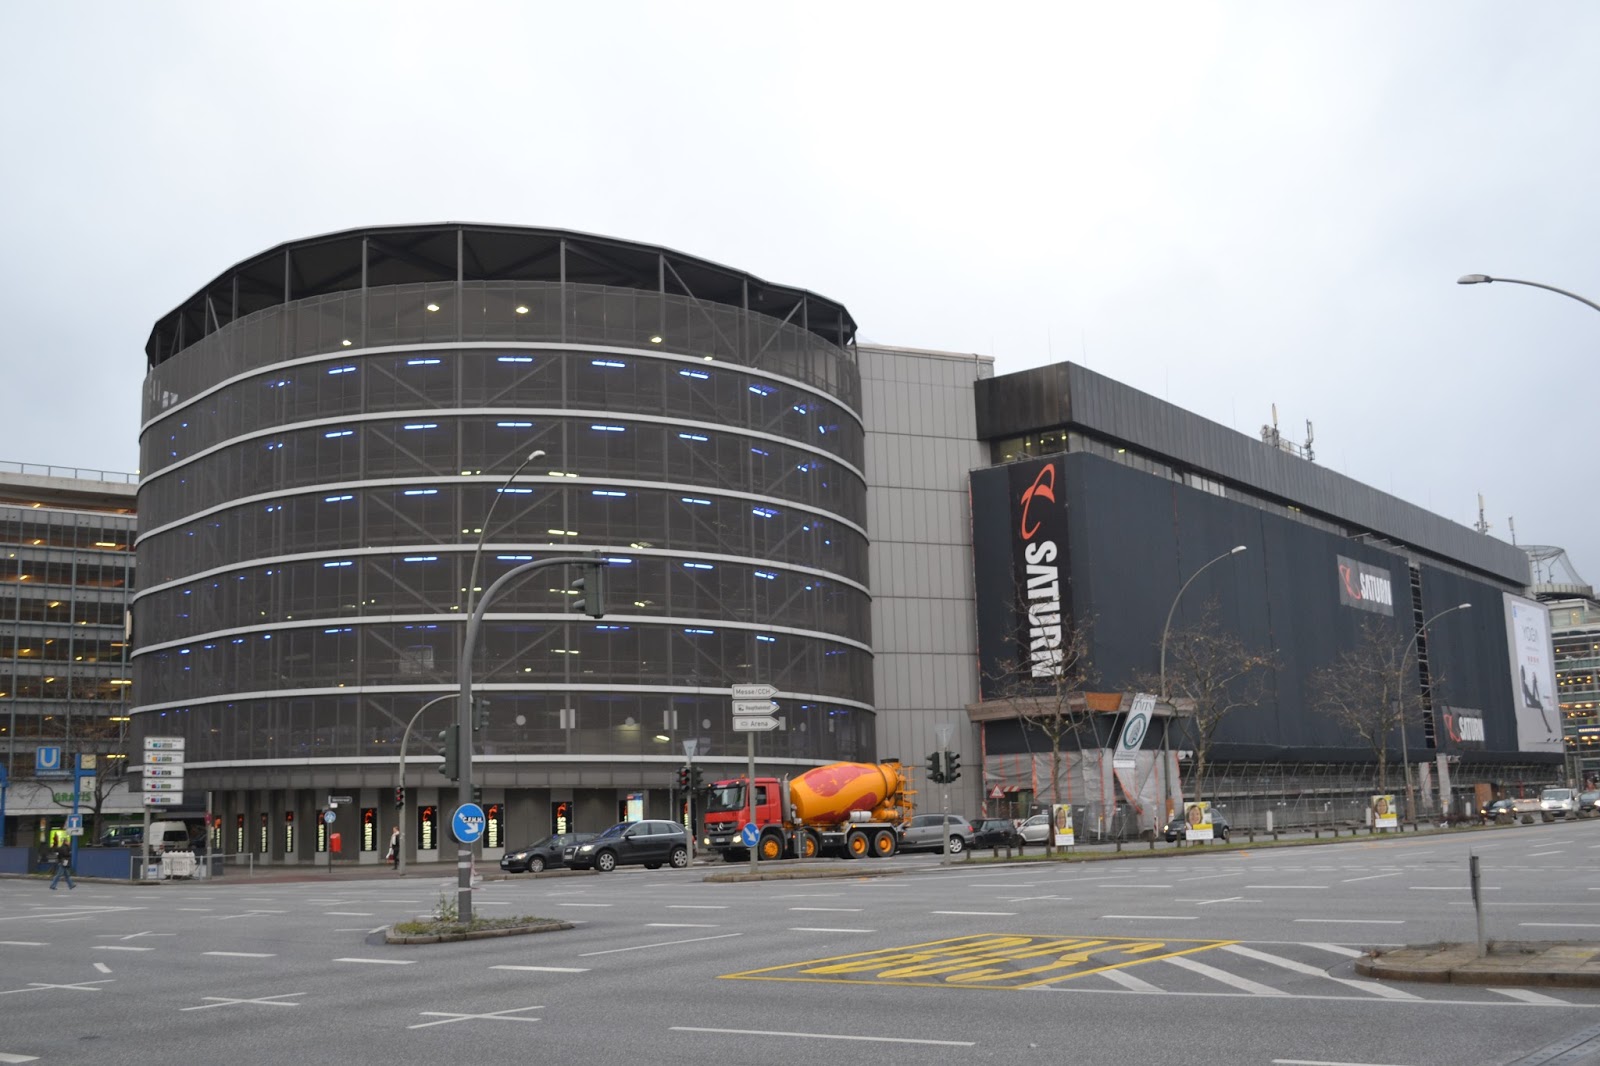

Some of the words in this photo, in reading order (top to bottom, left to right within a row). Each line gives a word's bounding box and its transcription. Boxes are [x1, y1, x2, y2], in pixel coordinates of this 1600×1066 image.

[1360, 572, 1392, 606] SATURN
[1025, 540, 1064, 678] SATURN
[1458, 716, 1485, 741] SATURN
[41, 749, 57, 767] U
[54, 792, 91, 801] GRAIS
[364, 823, 373, 851] SATURN
[423, 820, 432, 849] SATURN
[488, 819, 498, 848] SATURN
[557, 816, 567, 834] SATU
